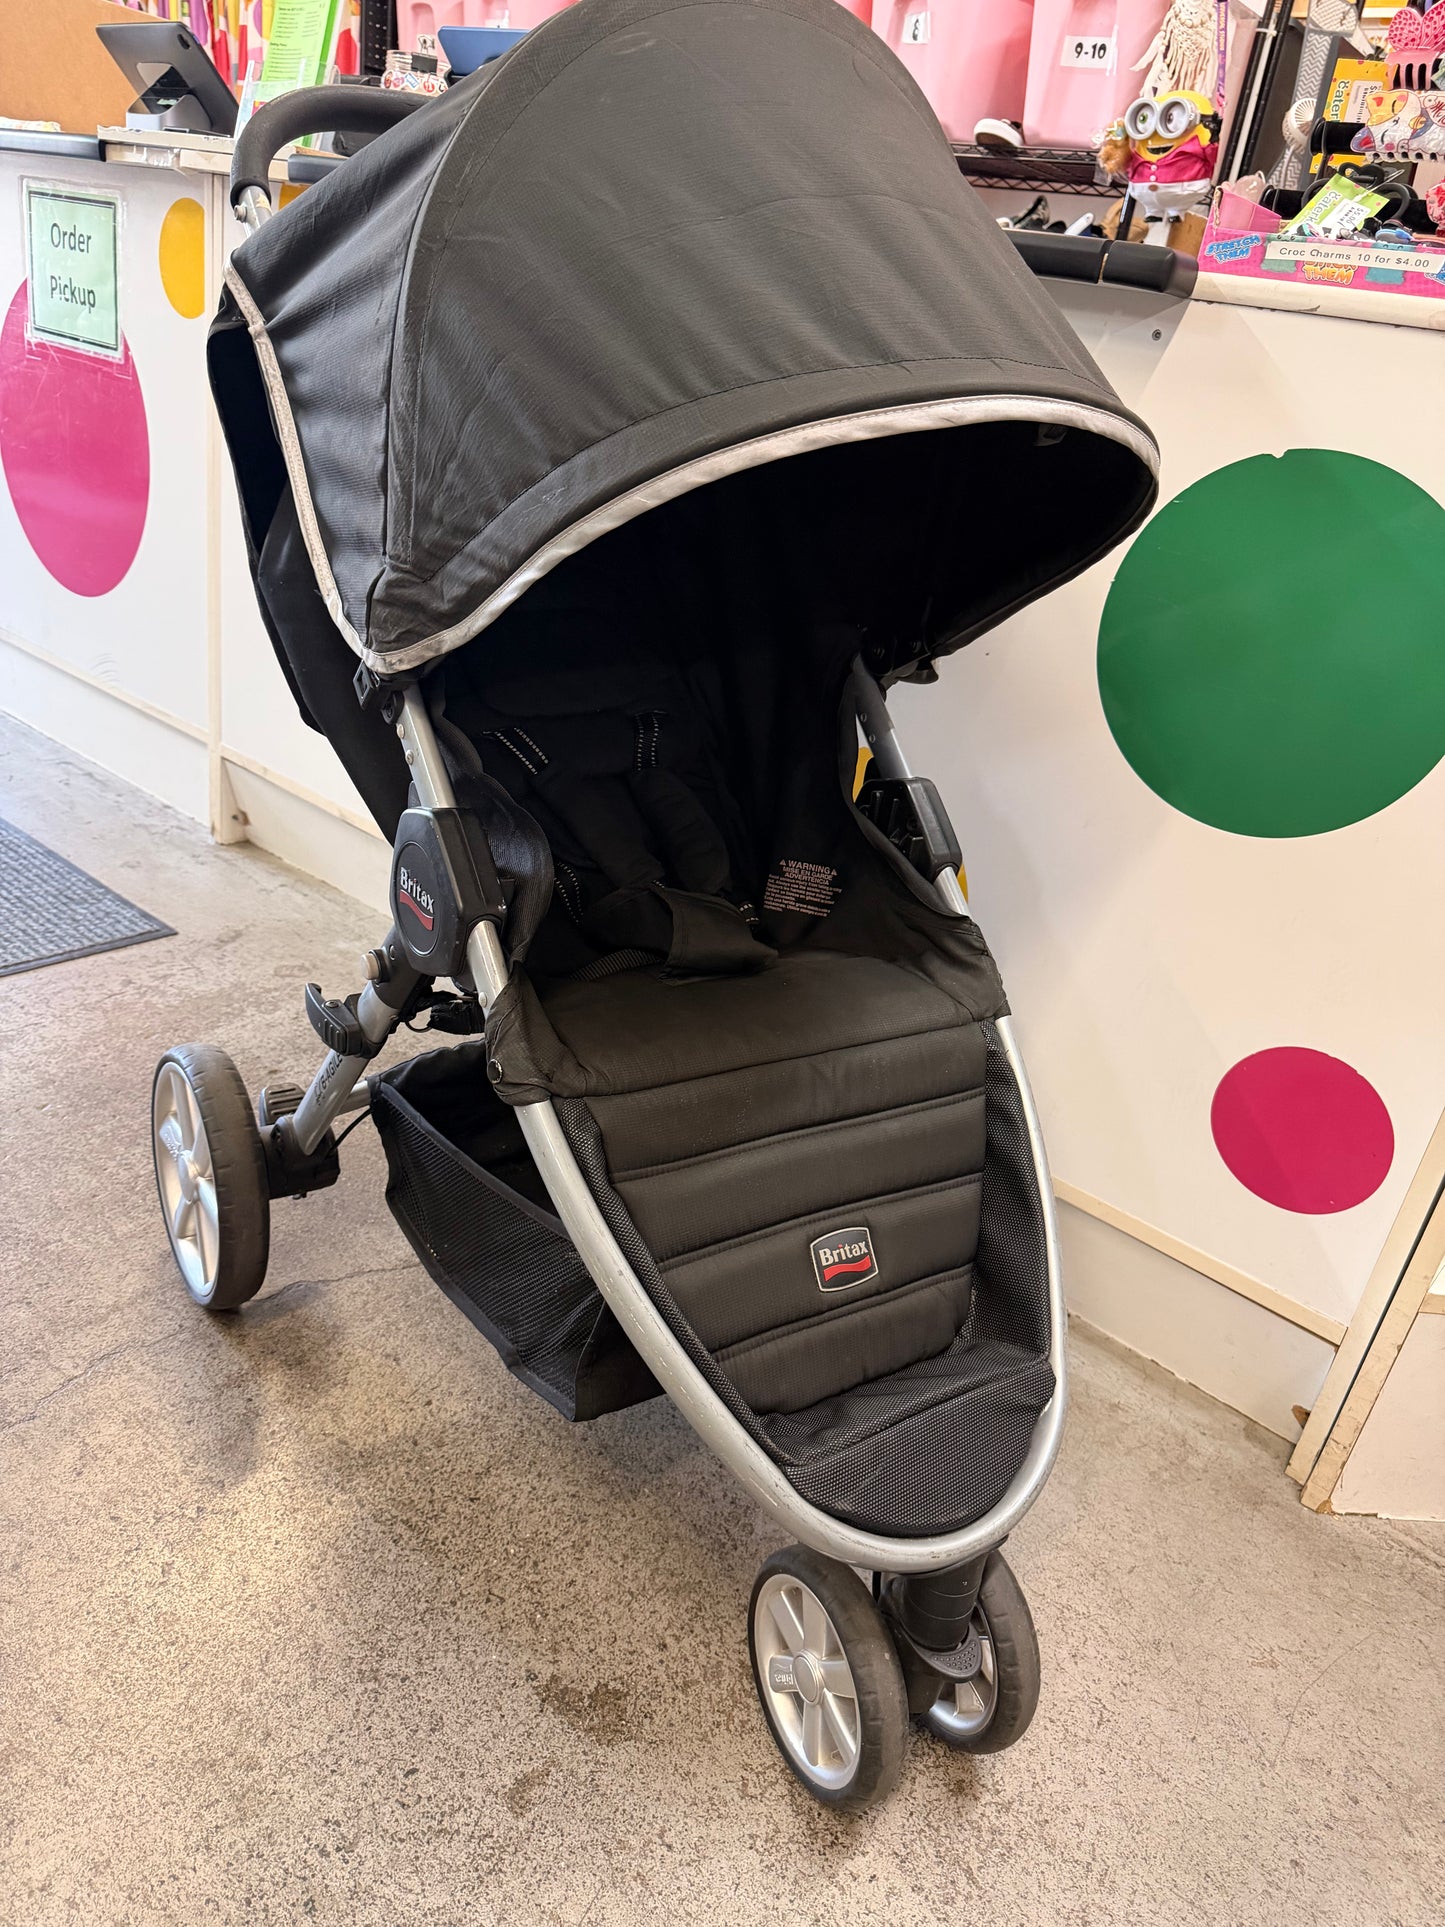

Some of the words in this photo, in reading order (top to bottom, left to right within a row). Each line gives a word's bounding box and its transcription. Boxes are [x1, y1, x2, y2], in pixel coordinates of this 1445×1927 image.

[1074, 42, 1107, 59] 9-10
[50, 222, 92, 254] Order
[1279, 247, 1306, 256] Croc
[1310, 249, 1352, 260] Charms
[1358, 253, 1371, 262] 10
[1374, 255, 1391, 264] for
[1395, 257, 1430, 268] $4.00
[1303, 264, 1354, 285] THEM
[50, 275, 96, 314] Pickup
[788, 860, 831, 874] WARNING
[784, 872, 830, 886] ADVERTENCIA
[400, 866, 434, 914] Britax
[818, 1241, 869, 1266] Britax
